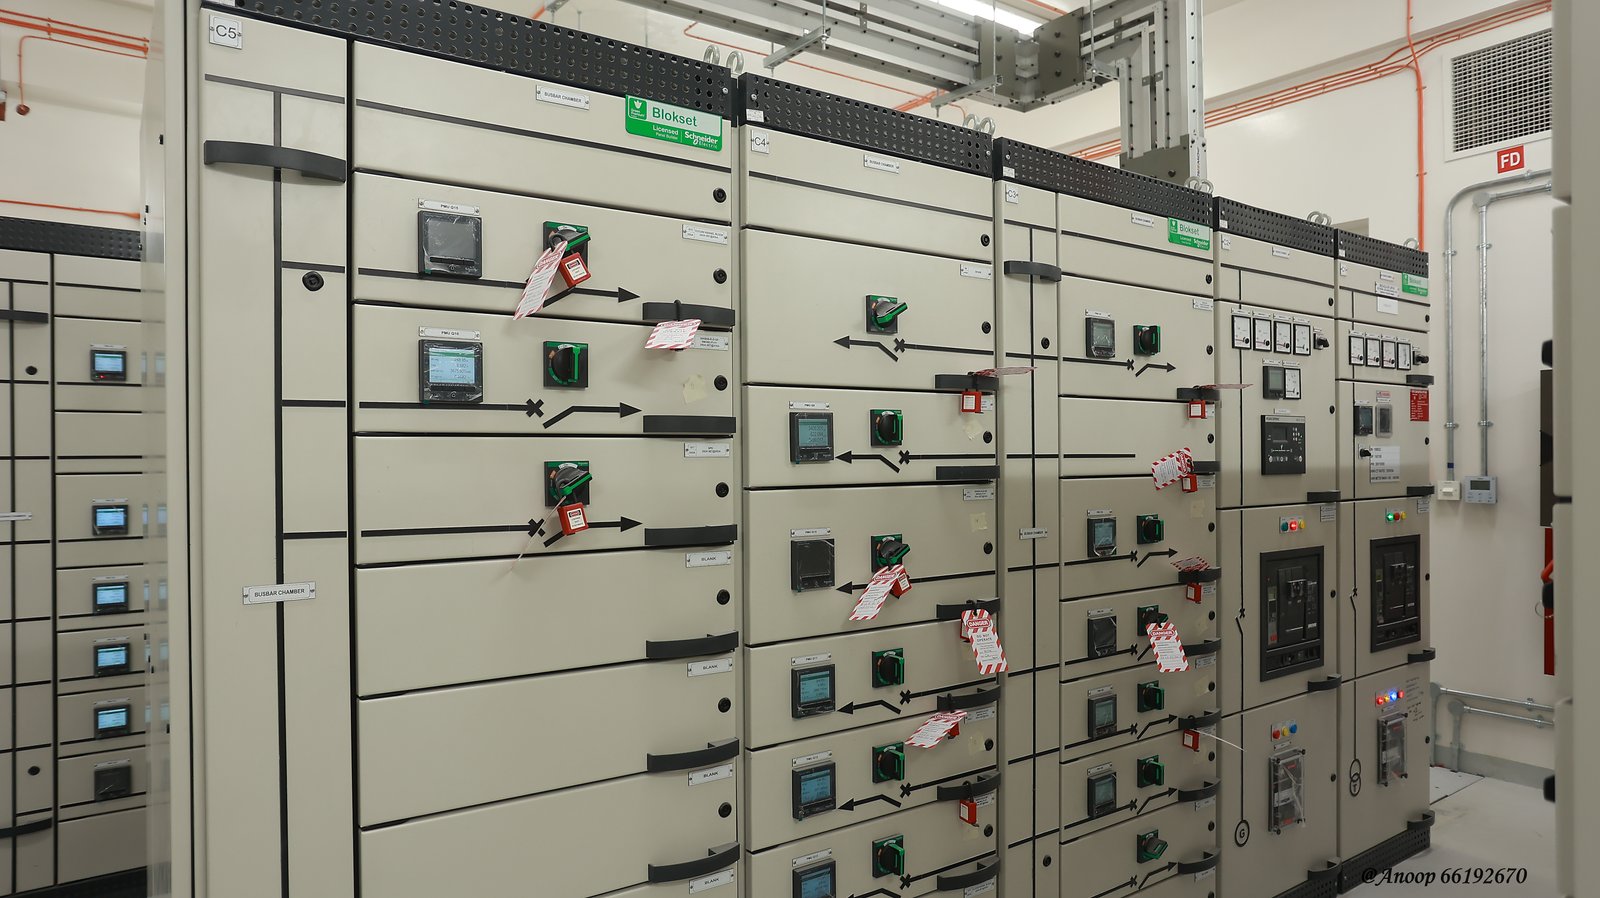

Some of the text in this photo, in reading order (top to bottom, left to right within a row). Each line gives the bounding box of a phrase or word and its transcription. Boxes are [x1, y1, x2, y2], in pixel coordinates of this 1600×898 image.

[216, 25, 237, 39] C5
[544, 91, 582, 103] BUSBAR CHAMBER
[652, 107, 698, 127] Blokset
[652, 125, 679, 136] Licensed
[684, 131, 718, 145] Schneider
[754, 136, 766, 147] C4
[1501, 151, 1521, 169] FD
[1008, 189, 1017, 198] C3
[1179, 223, 1200, 236] Blokset
[254, 588, 305, 598] BUSBAR CHAMBER
[1239, 828, 1246, 838] G
